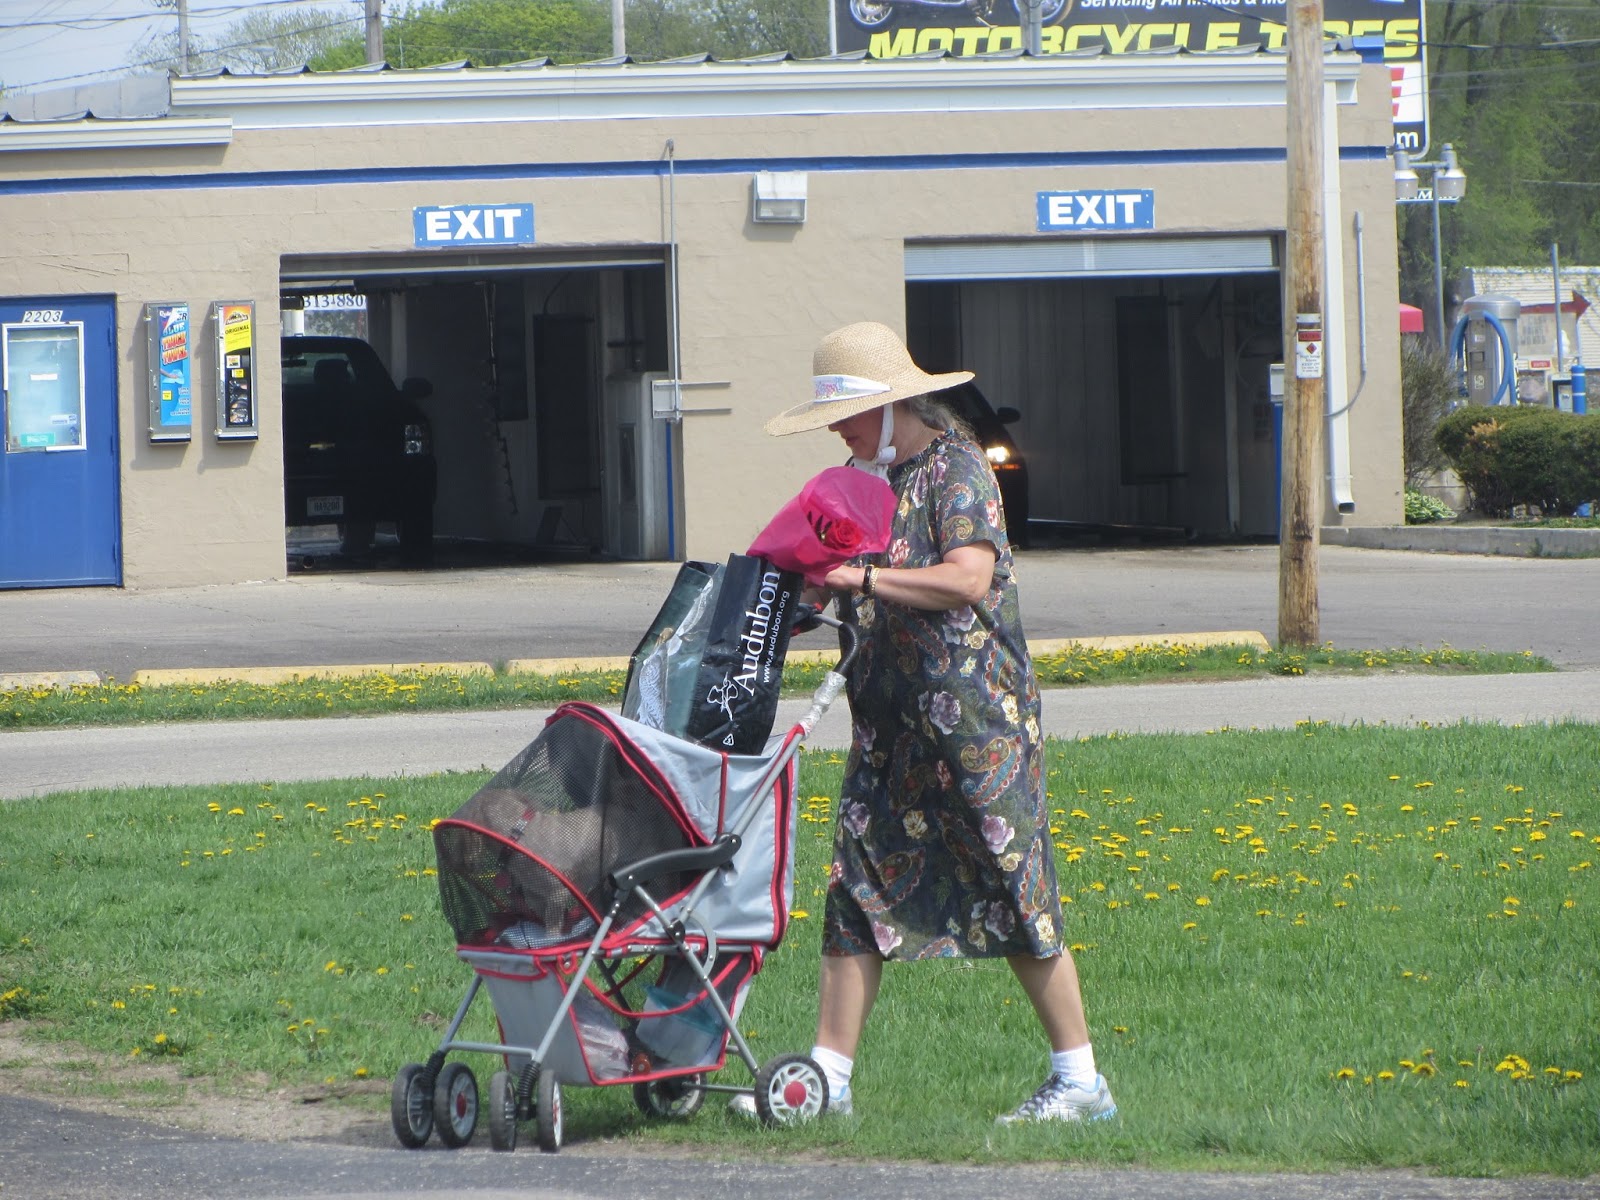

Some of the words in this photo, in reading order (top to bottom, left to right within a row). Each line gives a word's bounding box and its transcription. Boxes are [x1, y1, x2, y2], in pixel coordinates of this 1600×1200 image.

[1081, 0, 1156, 9] Servicing
[870, 22, 1241, 58] MOTORCYCLE
[1259, 19, 1420, 58] TES
[425, 208, 522, 241] EXIT
[1048, 194, 1142, 225] EXIT
[24, 310, 61, 323] 2203
[225, 325, 249, 335] ORIGINAL
[733, 571, 781, 697] Audubon
[763, 590, 790, 683] www.audubon.org
